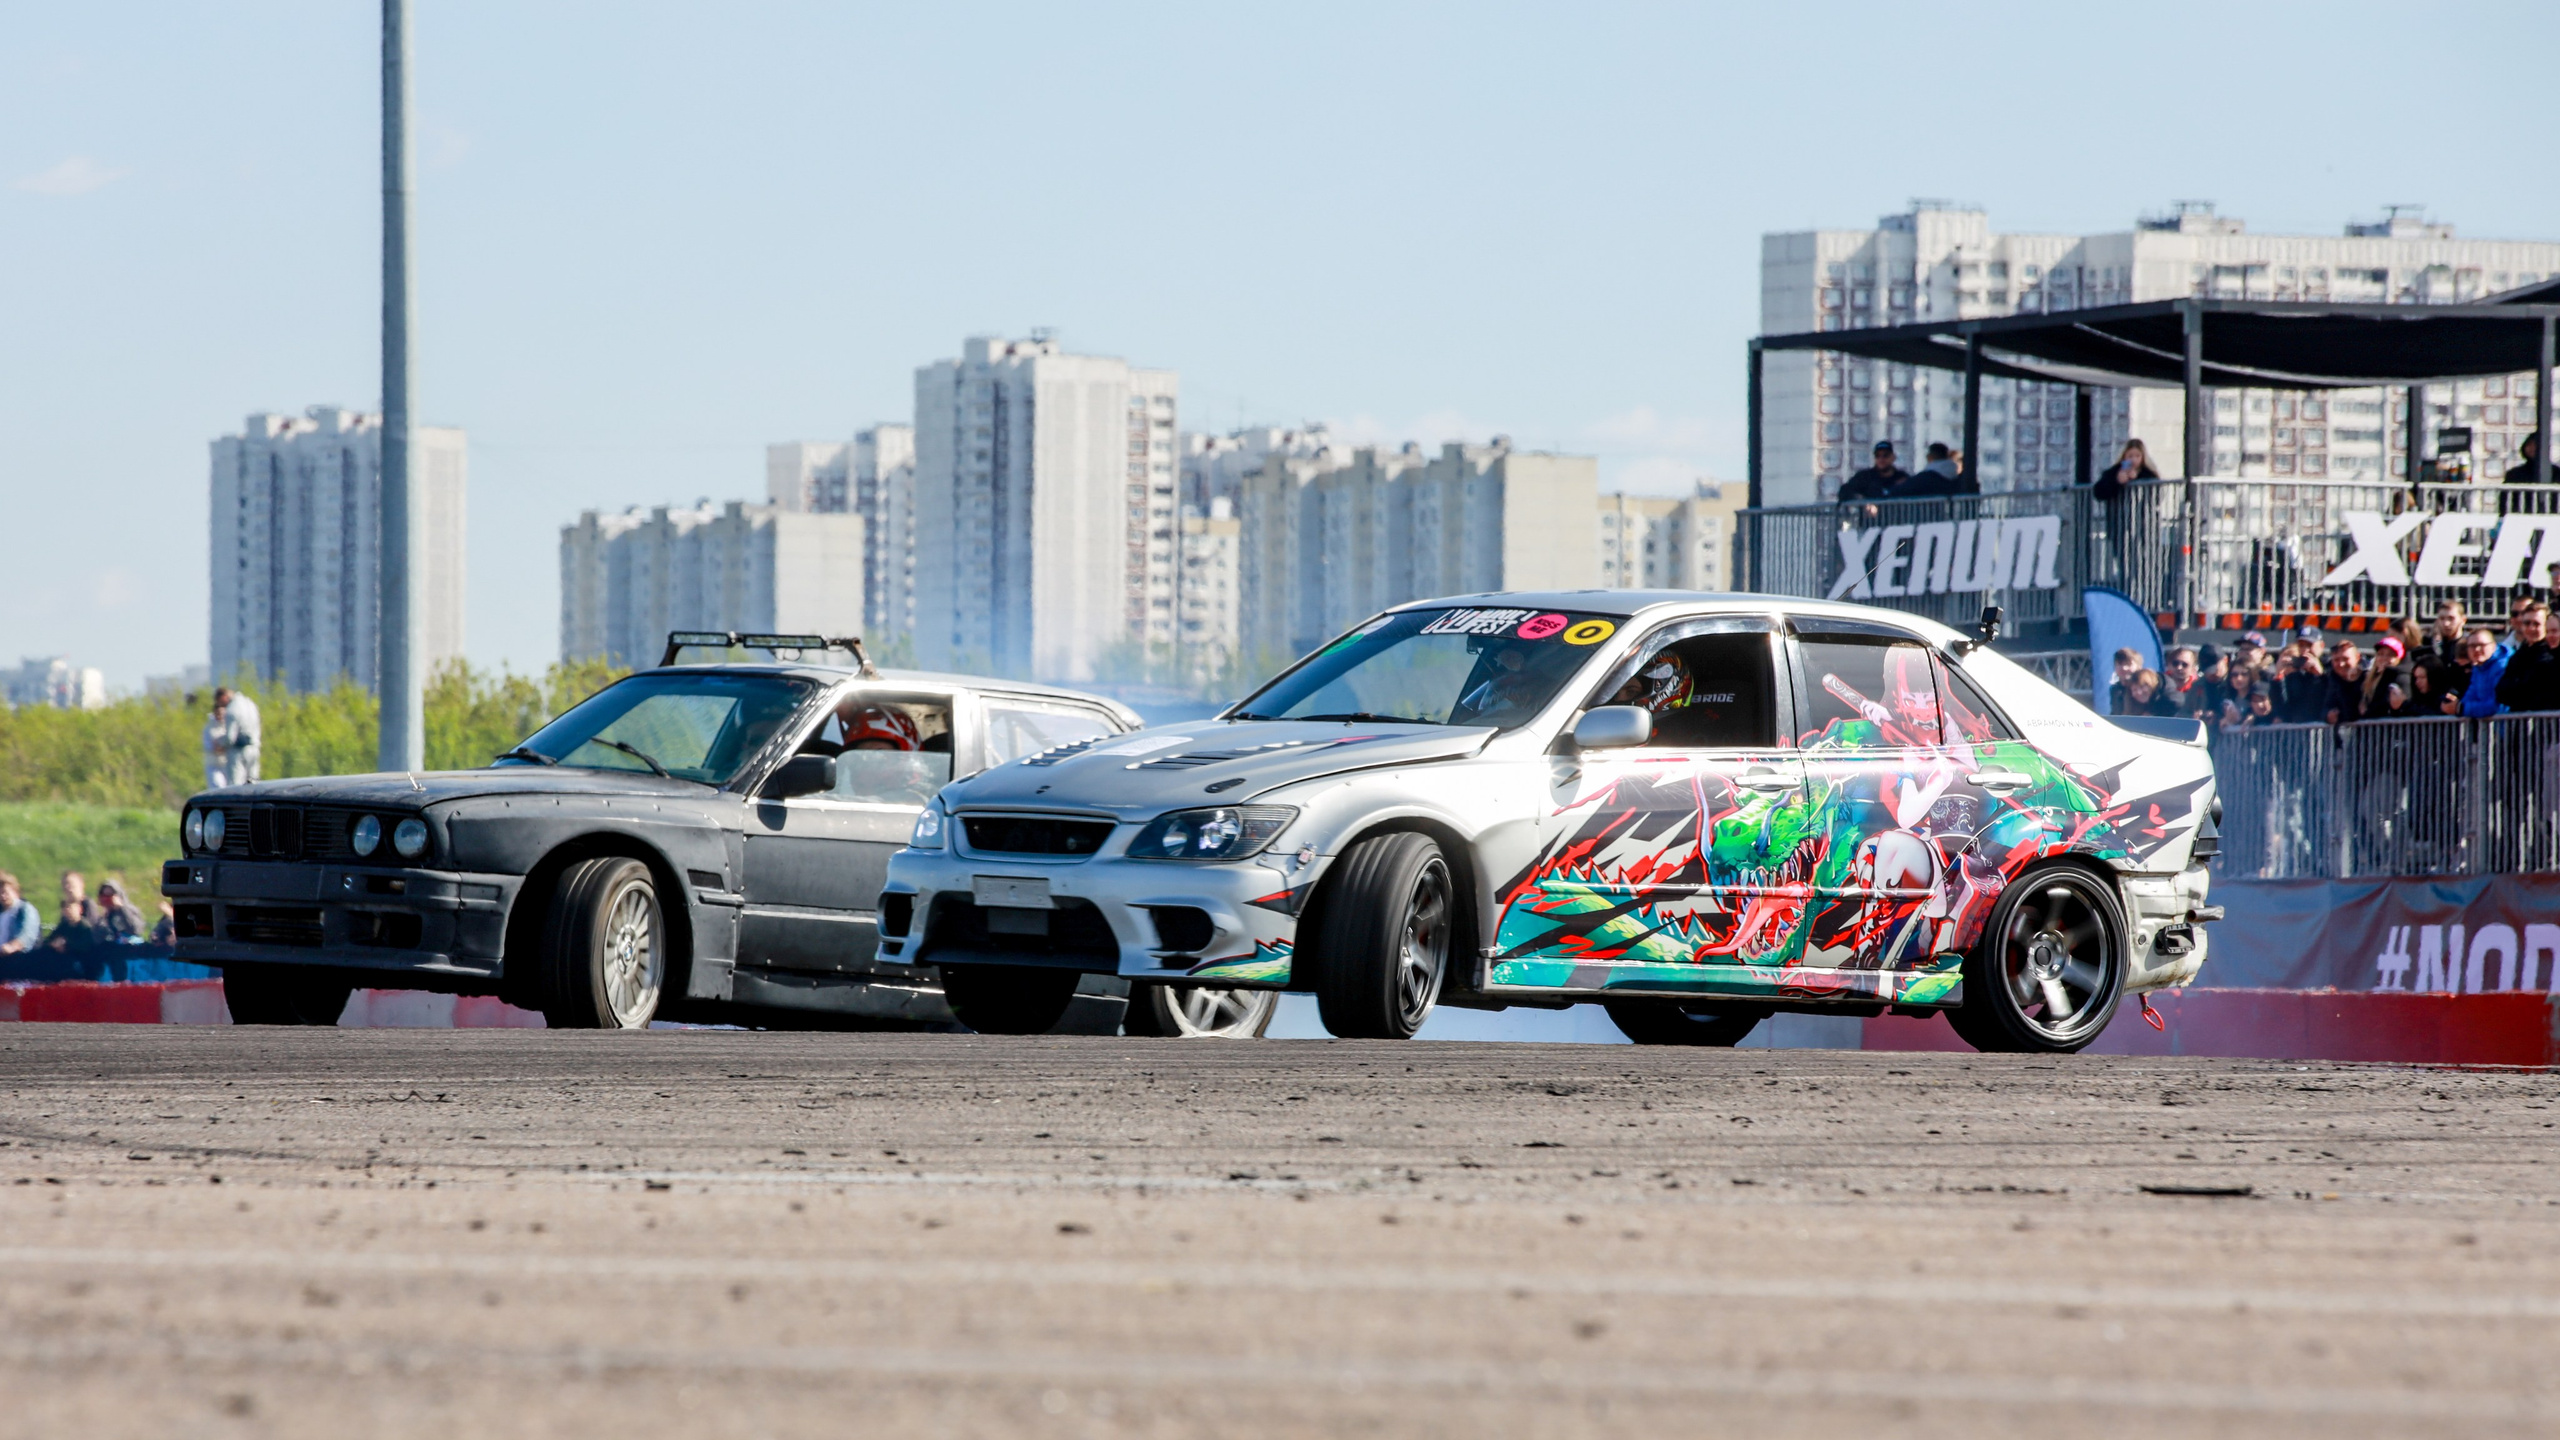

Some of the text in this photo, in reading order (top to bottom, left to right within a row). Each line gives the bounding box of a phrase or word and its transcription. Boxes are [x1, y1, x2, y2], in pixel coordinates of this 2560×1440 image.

[1826, 515, 2061, 600] XENUM
[1464, 618, 1519, 635] FEST
[1527, 625, 1548, 634] ME
[1534, 618, 1562, 630] KISS
[1691, 693, 1736, 704] BRIDE
